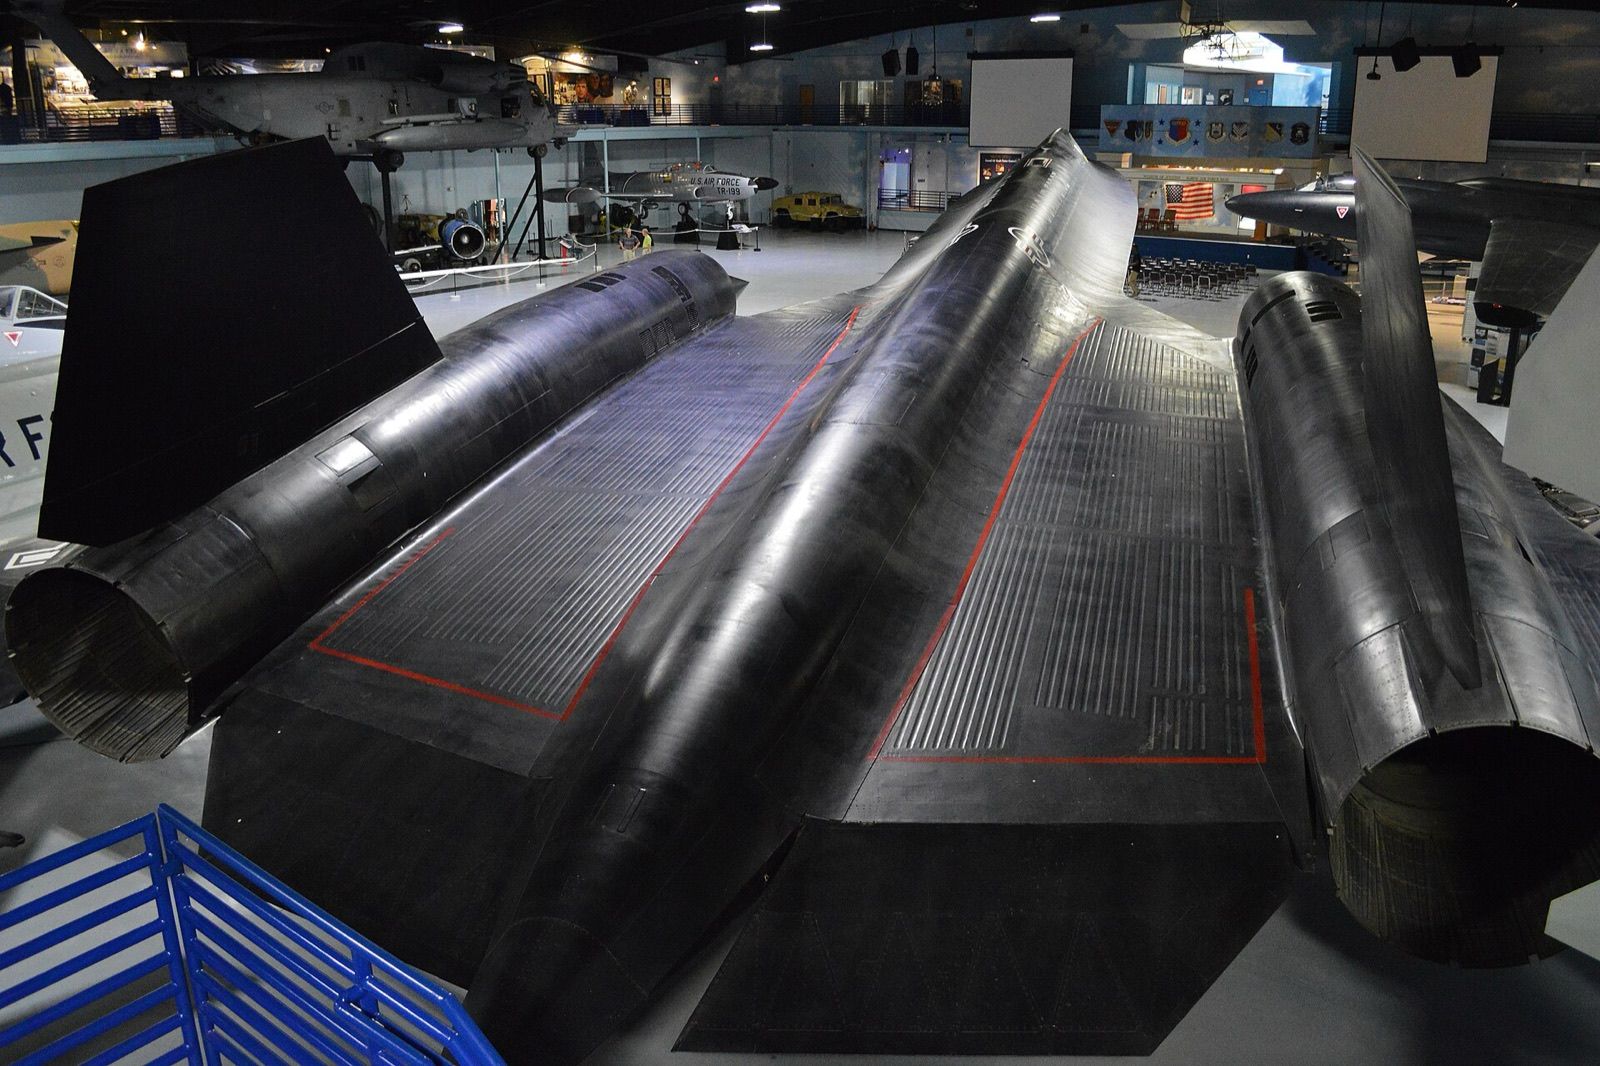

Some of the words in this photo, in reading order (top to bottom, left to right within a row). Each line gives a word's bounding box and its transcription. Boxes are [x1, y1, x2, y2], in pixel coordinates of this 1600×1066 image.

[704, 178, 715, 187] AIR
[717, 178, 740, 187] FORCE
[717, 187, 741, 195] TR-199
